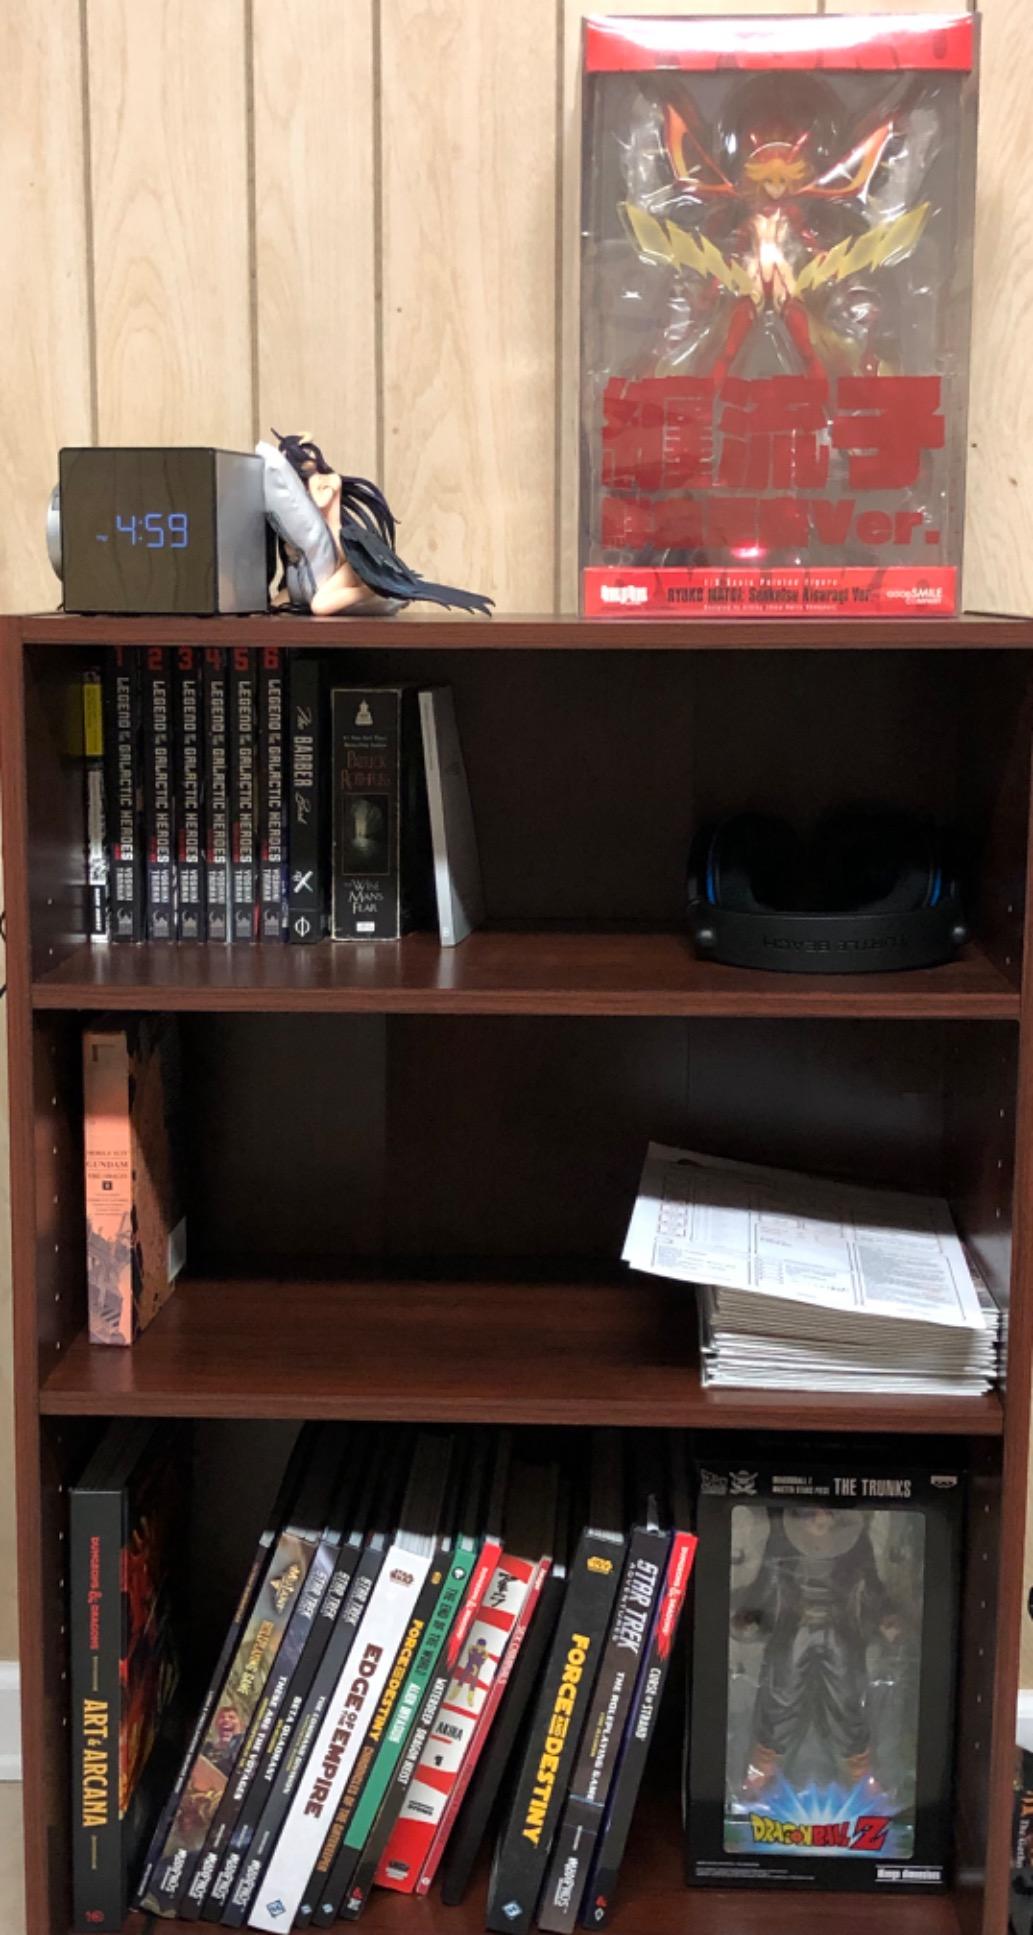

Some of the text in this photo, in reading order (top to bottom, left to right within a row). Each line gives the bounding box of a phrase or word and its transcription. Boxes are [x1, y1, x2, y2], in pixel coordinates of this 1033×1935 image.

[116, 513, 190, 548] 4:59
[149, 647, 162, 671] 2
[179, 646, 193, 670] 3
[206, 648, 220, 671] 4
[234, 648, 248, 671] 5
[264, 647, 279, 670] 6
[117, 677, 133, 861] LEGEND GALACTIC HEROES
[152, 680, 169, 862] LEGEND GALACTIC HEROES
[182, 680, 198, 862] LEGEND GALACTIC HEROES
[211, 681, 226, 863] LEGEND GALACTIC HEROES
[239, 681, 252, 863] LEGEND GALACTIC HEROES
[268, 679, 281, 862] LEGEND GALACTIC HEROES
[294, 736, 313, 787] BARBER
[833, 1477, 857, 1496] THE
[861, 1478, 912, 1498] TRUNKS
[614, 1558, 660, 1654] STAR TREK
[395, 1617, 424, 1667] FORCE
[342, 1641, 385, 1713] EDGE
[553, 1632, 591, 1716] FORCE
[611, 1671, 625, 1693] THE
[83, 1698, 107, 1736] ART
[366, 1677, 401, 1742] DESTINY
[593, 1693, 619, 1768] ROLEPLAYING
[260, 1722, 291, 1782] QUADRANT
[300, 1724, 352, 1821] EMPIRE
[82, 1749, 108, 1827] ARCANA
[519, 1734, 564, 1845] DESTINY
[585, 1768, 600, 1800] GAME
[850, 1816, 892, 1851] Z
